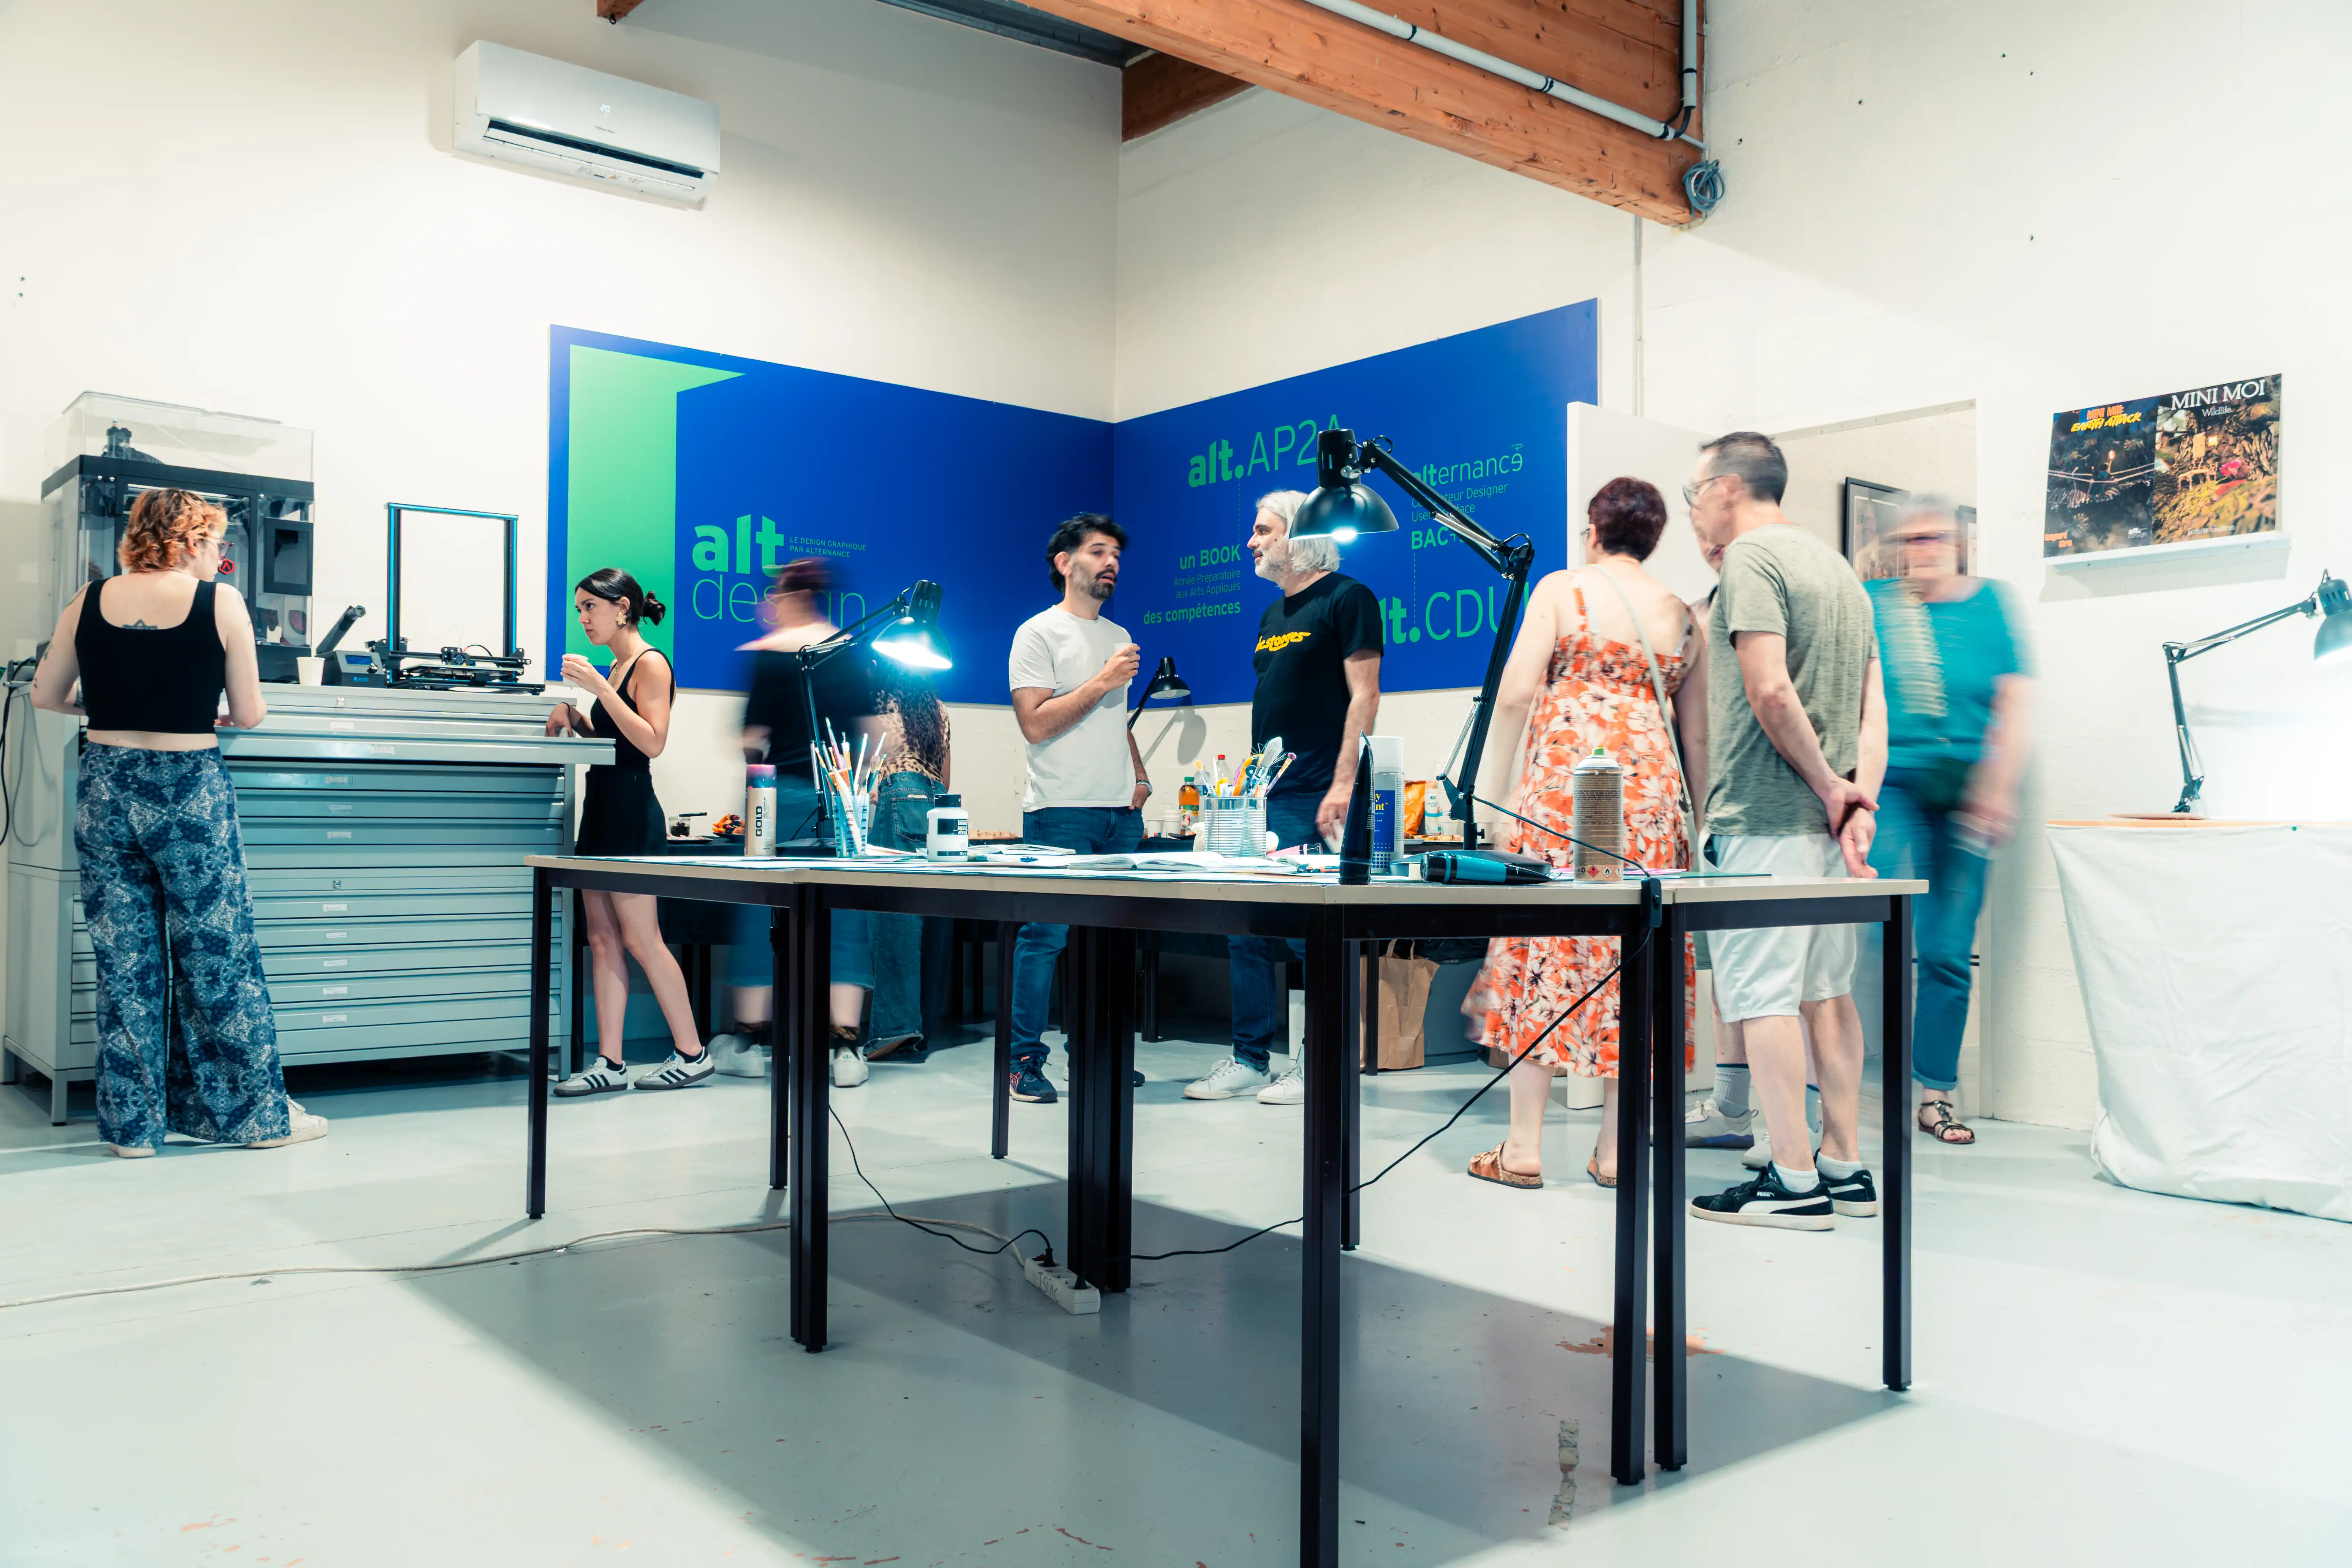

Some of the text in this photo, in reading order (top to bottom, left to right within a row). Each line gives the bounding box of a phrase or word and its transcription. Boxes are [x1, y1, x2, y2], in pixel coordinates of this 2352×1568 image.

[2171, 379, 2265, 411] MINI MOI
[2086, 408, 2105, 420] MINI
[2202, 406, 2232, 417] Wildlife
[2071, 412, 2142, 432] EARTH ATTACK
[1467, 484, 1508, 499] Designer
[801, 537, 825, 546] DESIGN
[828, 541, 866, 551] GRAPHIQUE
[806, 547, 850, 558] ALTERNANCE
[1180, 544, 1241, 569] un BOOK
[1174, 569, 1241, 587] Année Préparatoire
[1190, 587, 1204, 597] Arts
[1206, 580, 1241, 596] Appliqués
[1144, 602, 1241, 624] des compétences
